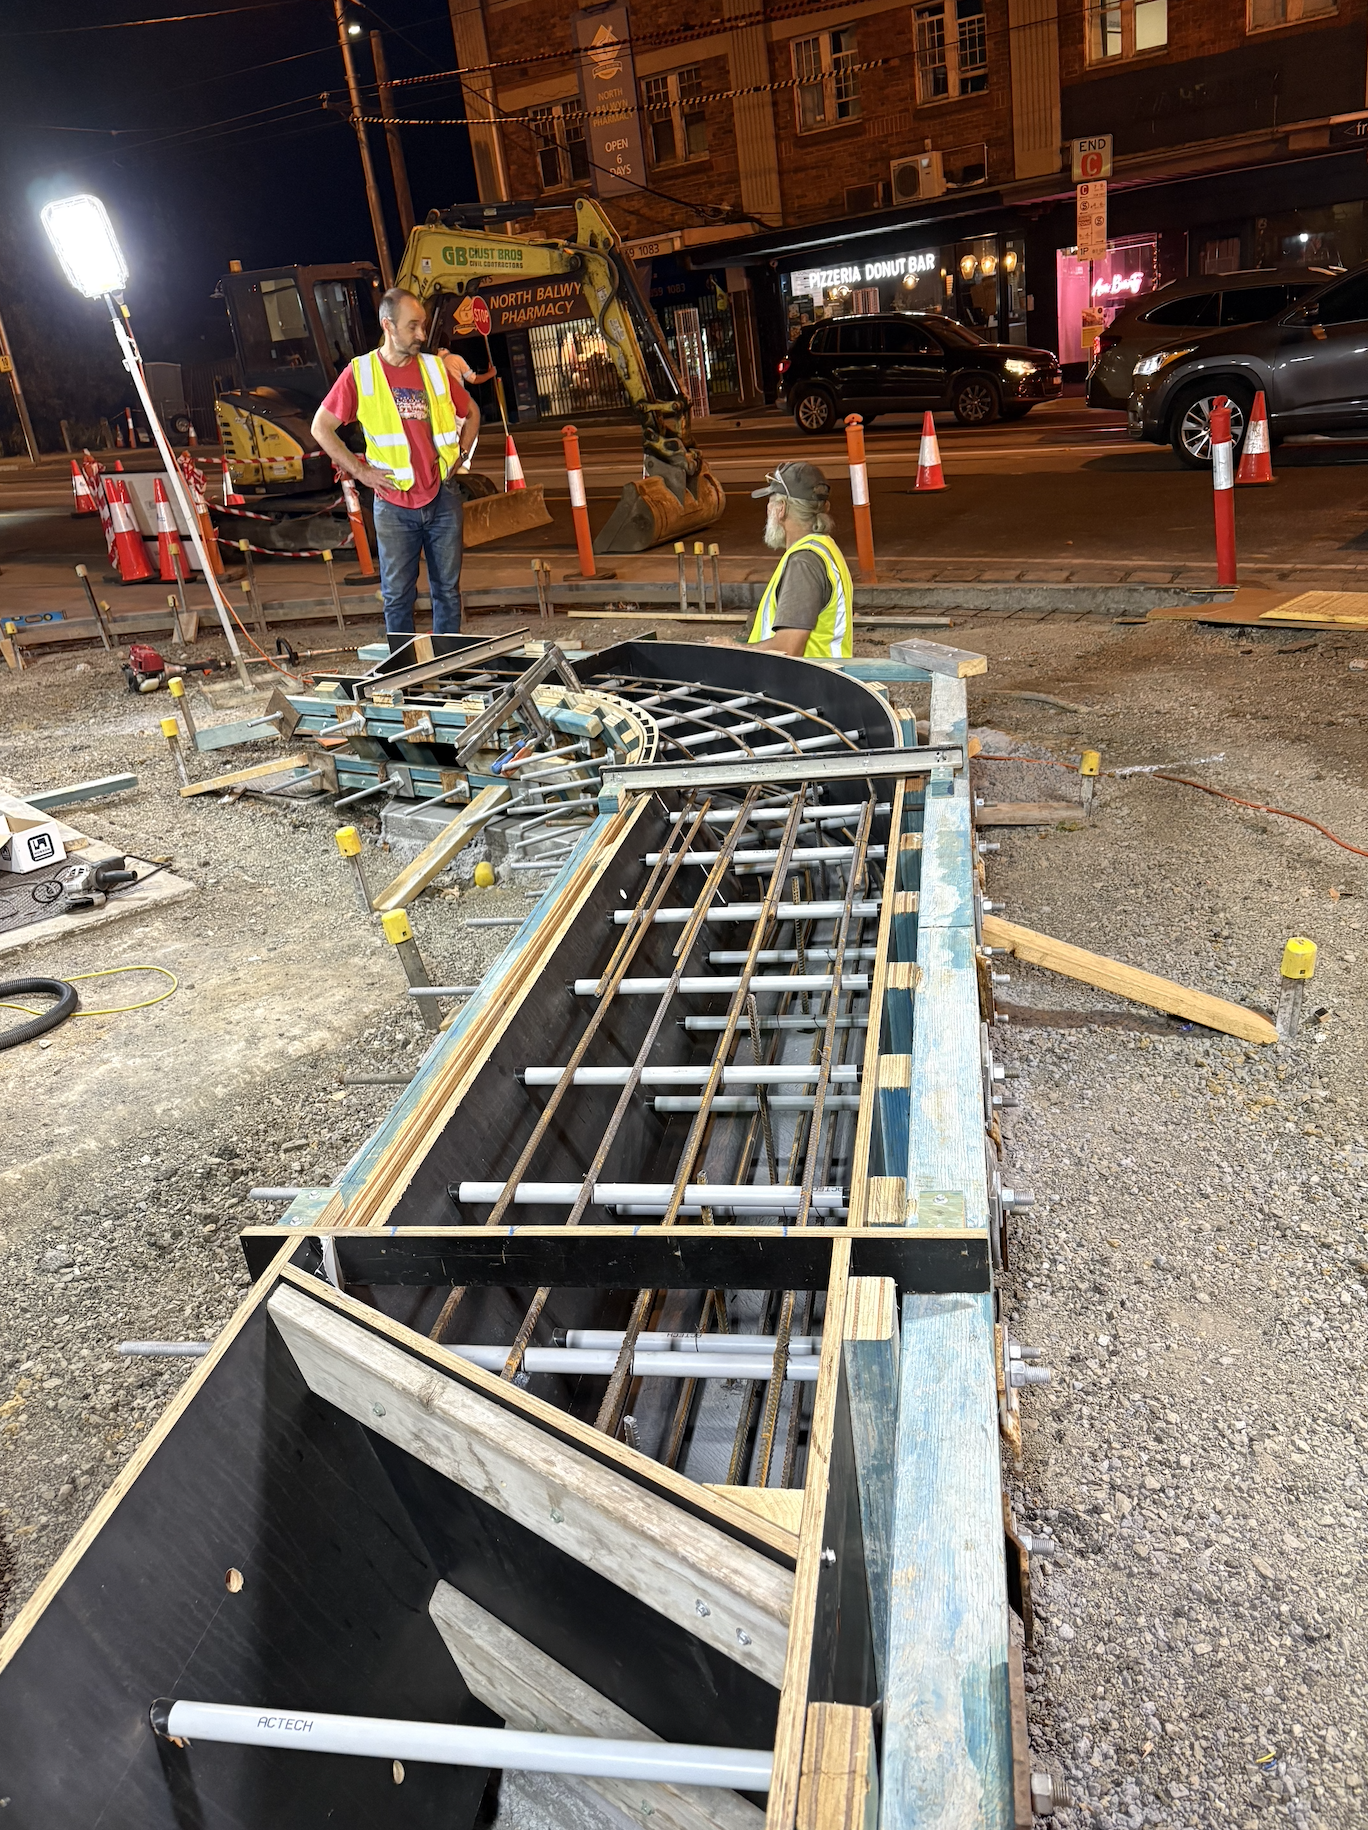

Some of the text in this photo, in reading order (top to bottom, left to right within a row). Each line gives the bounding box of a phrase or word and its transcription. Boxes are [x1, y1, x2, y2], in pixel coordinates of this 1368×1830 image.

[598, 88, 623, 101] NORTH
[595, 99, 628, 112] BALWYN
[593, 112, 633, 127] PHARMACY
[605, 138, 629, 152] OPEN
[1079, 138, 1106, 152] END
[616, 153, 623, 164] 6
[609, 164, 632, 178] DAYS
[442, 246, 468, 266] GB
[638, 243, 660, 256] 1083
[1080, 247, 1089, 256] 1P
[484, 261, 523, 269] CONTRACTORS
[809, 265, 862, 289] PIZZERIA
[865, 258, 906, 281] DONUT
[908, 253, 935, 273] BAR
[490, 289, 532, 309] NORTH
[536, 281, 582, 301] BALWY
[666, 283, 686, 294] 1083
[473, 308, 490, 323] STOP
[501, 300, 575, 325] PHARMACY
[257, 1716, 314, 1733] ACTECH
